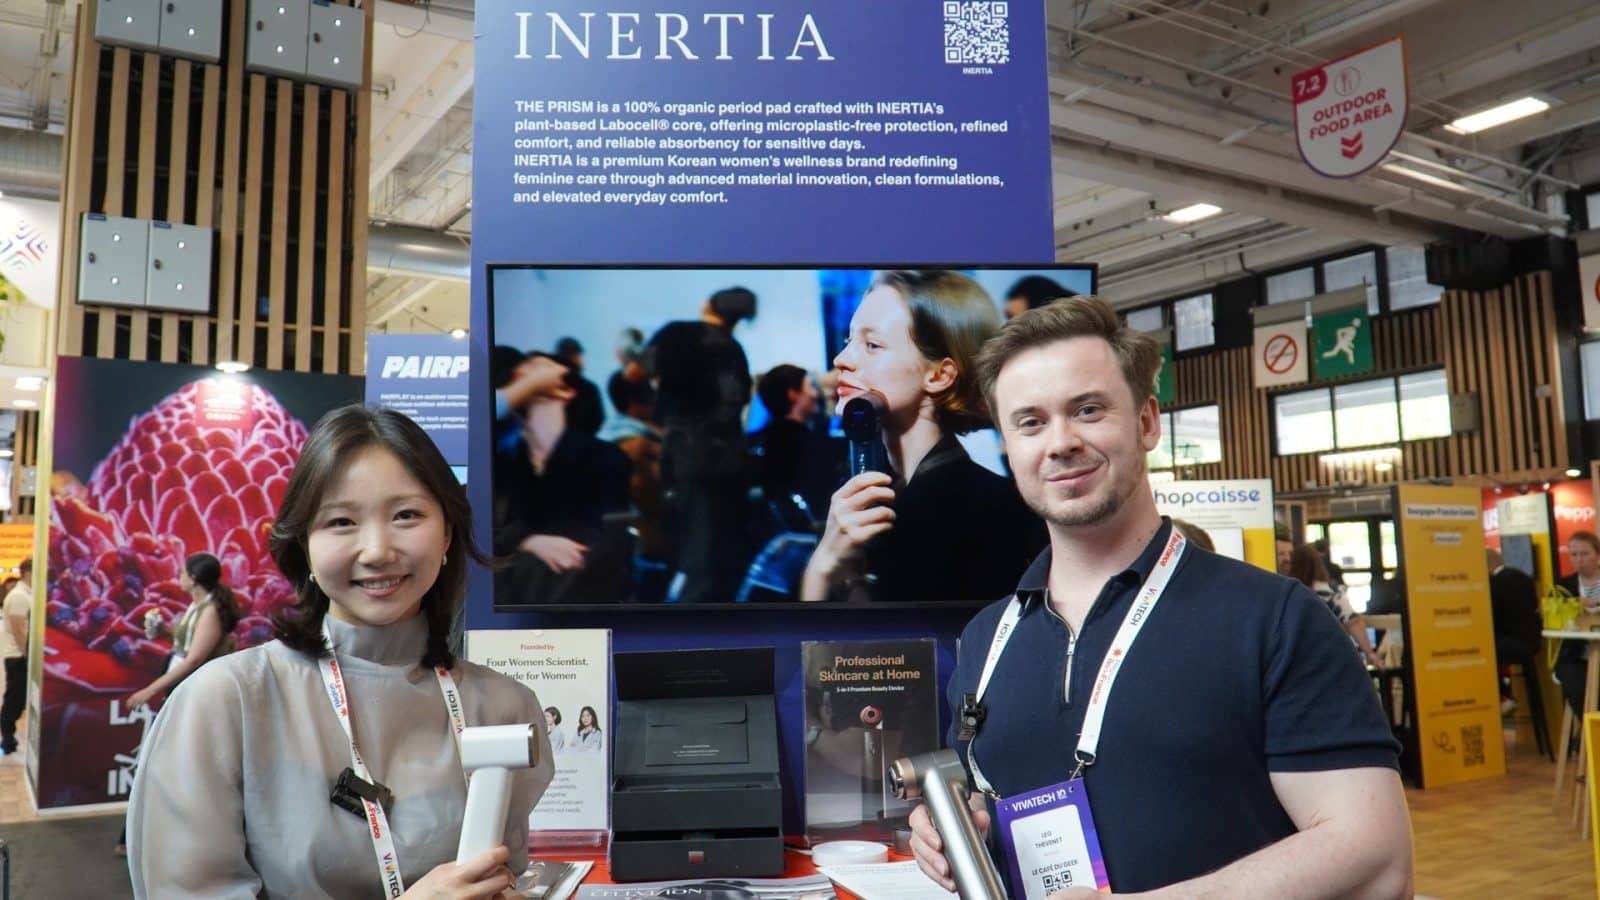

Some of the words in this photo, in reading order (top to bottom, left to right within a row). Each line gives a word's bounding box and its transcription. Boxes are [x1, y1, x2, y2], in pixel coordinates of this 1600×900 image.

[513, 12, 836, 61] INERTIA
[962, 67, 993, 75] INERTIA
[1297, 75, 1320, 96] 7.2
[514, 100, 544, 112] THE
[547, 100, 593, 112] PRISM
[596, 100, 608, 112] is
[611, 103, 620, 112] a
[623, 101, 660, 112] 100%
[663, 101, 715, 115] organic
[718, 101, 762, 116] period
[765, 101, 791, 116] pad
[793, 101, 842, 114] crafted
[844, 101, 873, 114] with
[1313, 88, 1386, 122] OUTDOOR
[514, 118, 595, 133] plant-based
[672, 121, 706, 132] core,
[710, 119, 763, 134] offering
[766, 119, 881, 134] microplastic-free
[884, 119, 957, 134] protection,
[960, 119, 1008, 132] refined
[1310, 117, 1349, 139] FOOD
[1353, 101, 1393, 125] AREA
[514, 136, 572, 149] comfort,
[575, 136, 601, 148] and
[605, 136, 656, 148] reliable
[659, 136, 739, 151] absorbency
[742, 136, 762, 149] for
[765, 136, 825, 149] sensitive
[829, 137, 865, 152] days.
[514, 154, 572, 166] INERTIA
[576, 154, 588, 166] is
[591, 156, 599, 166] a
[603, 154, 663, 168] premium
[667, 154, 716, 166] Korean
[783, 154, 842, 167] wellness
[846, 154, 886, 167] brand
[888, 154, 957, 170] redefining
[513, 172, 573, 184] feminine
[576, 174, 607, 184] care
[609, 172, 664, 187] through
[667, 172, 734, 184] advanced
[737, 172, 792, 185] material
[795, 172, 871, 186] innovation,
[874, 172, 911, 185] clean
[914, 172, 1004, 187] formulations,
[512, 190, 539, 202] and
[542, 190, 600, 202] elevated
[603, 190, 666, 205] everyday
[669, 190, 728, 203] comfort.
[486, 658, 507, 667] Four
[508, 657, 544, 667] Women
[835, 654, 905, 667] Professional
[526, 671, 539, 680] for
[541, 671, 577, 680] Women
[819, 669, 870, 682] Skincare
[872, 669, 884, 680] at
[887, 669, 921, 680] Home
[446, 689, 464, 734] VIVATECH
[1012, 791, 1056, 812] VIVATECH
